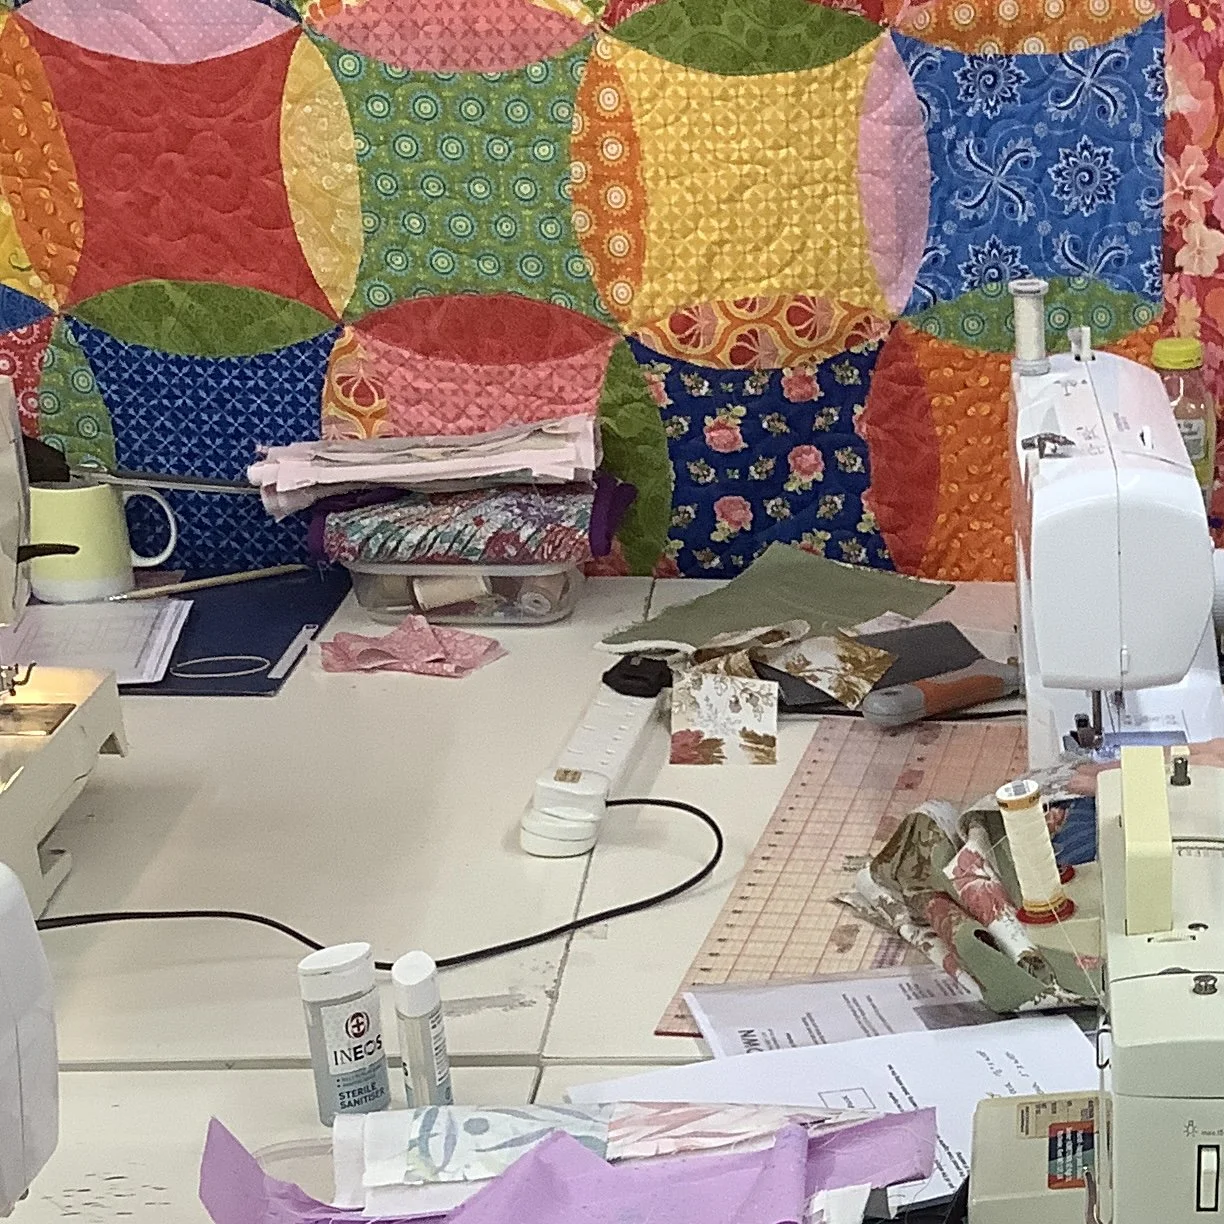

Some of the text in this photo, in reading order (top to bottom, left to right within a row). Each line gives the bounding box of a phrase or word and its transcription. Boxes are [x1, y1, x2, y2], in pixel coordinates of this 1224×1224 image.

[333, 1033, 383, 1066] INEOS
[339, 1081, 377, 1101] STERILE
[340, 1087, 385, 1110] SANITISER
